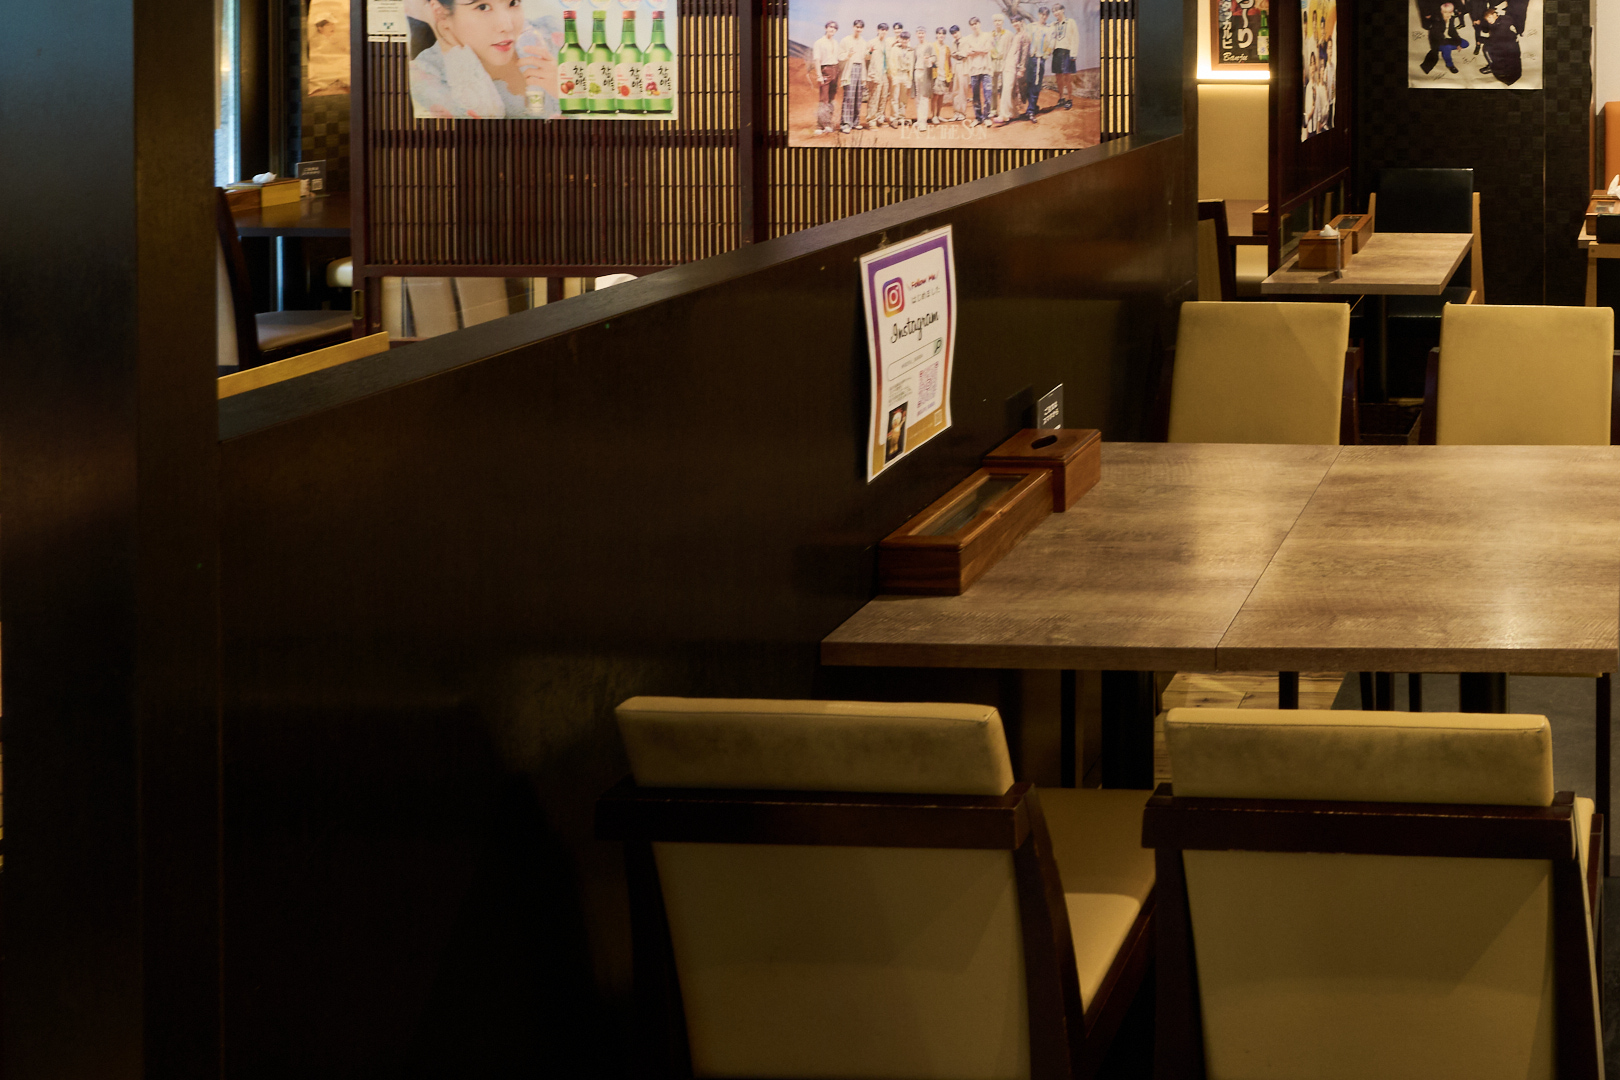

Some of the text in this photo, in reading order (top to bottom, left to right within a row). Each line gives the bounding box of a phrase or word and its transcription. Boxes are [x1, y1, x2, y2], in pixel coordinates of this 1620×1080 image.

[1223, 52, 1249, 62] Banju
[936, 124, 960, 140] THE
[962, 119, 988, 140] SUN
[890, 311, 939, 344] Instagram
